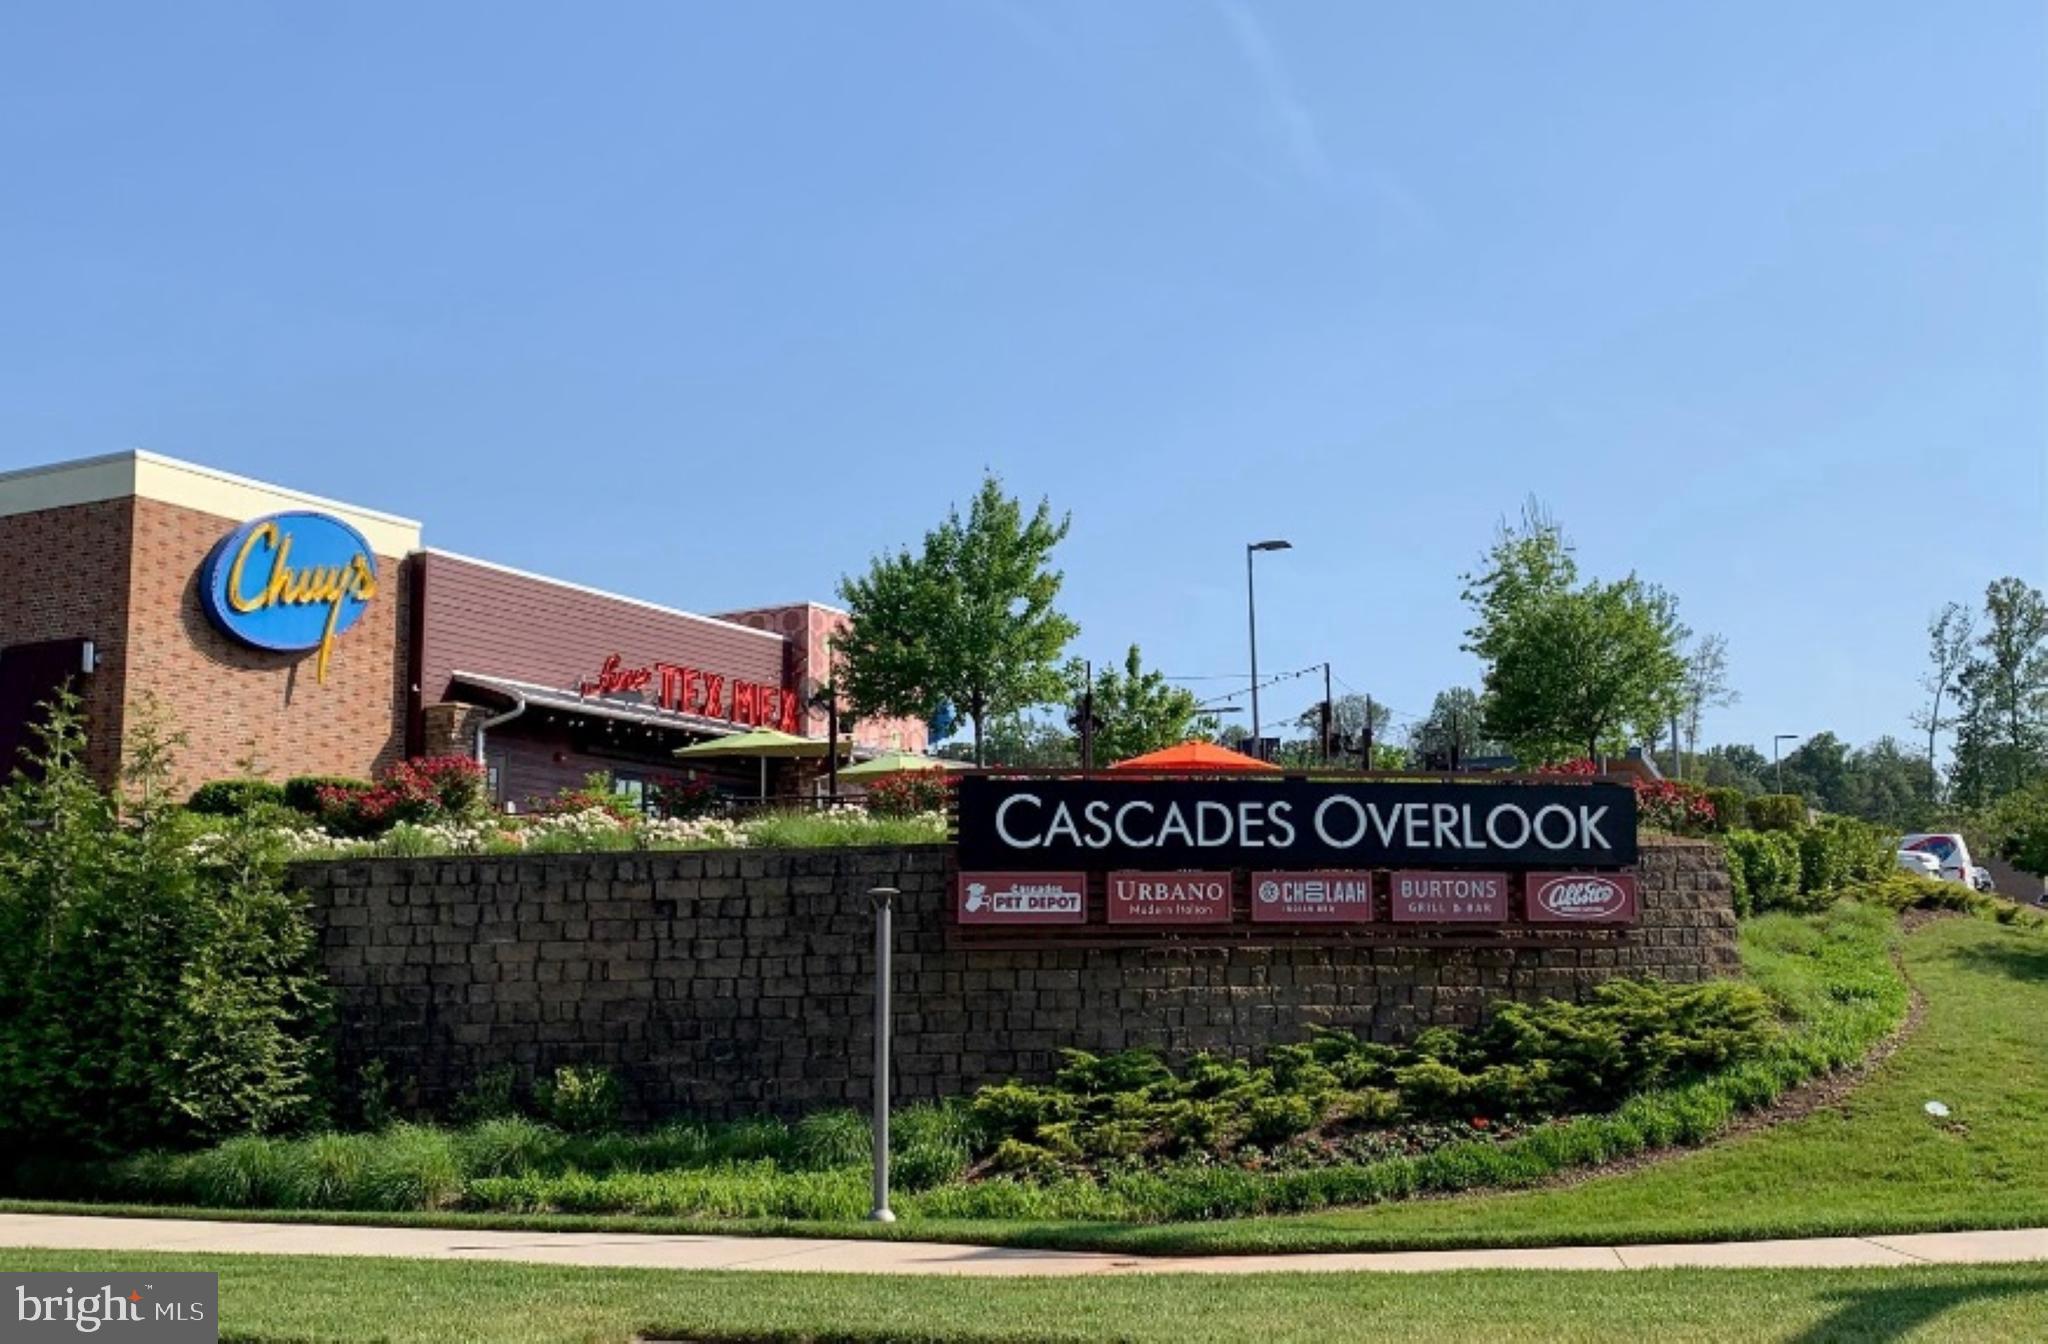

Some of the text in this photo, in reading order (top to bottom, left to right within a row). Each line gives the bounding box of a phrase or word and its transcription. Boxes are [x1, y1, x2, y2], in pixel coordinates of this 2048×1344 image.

[655, 662, 724, 718] TEX
[731, 678, 800, 733] MEX
[995, 793, 1612, 849] CASCADES OVERLOOK
[1116, 881, 1225, 901] URBANO
[1401, 880, 1497, 899] BURTONS
[995, 896, 1078, 909] PET DEPOT
[1408, 902, 1446, 913] GRILL
